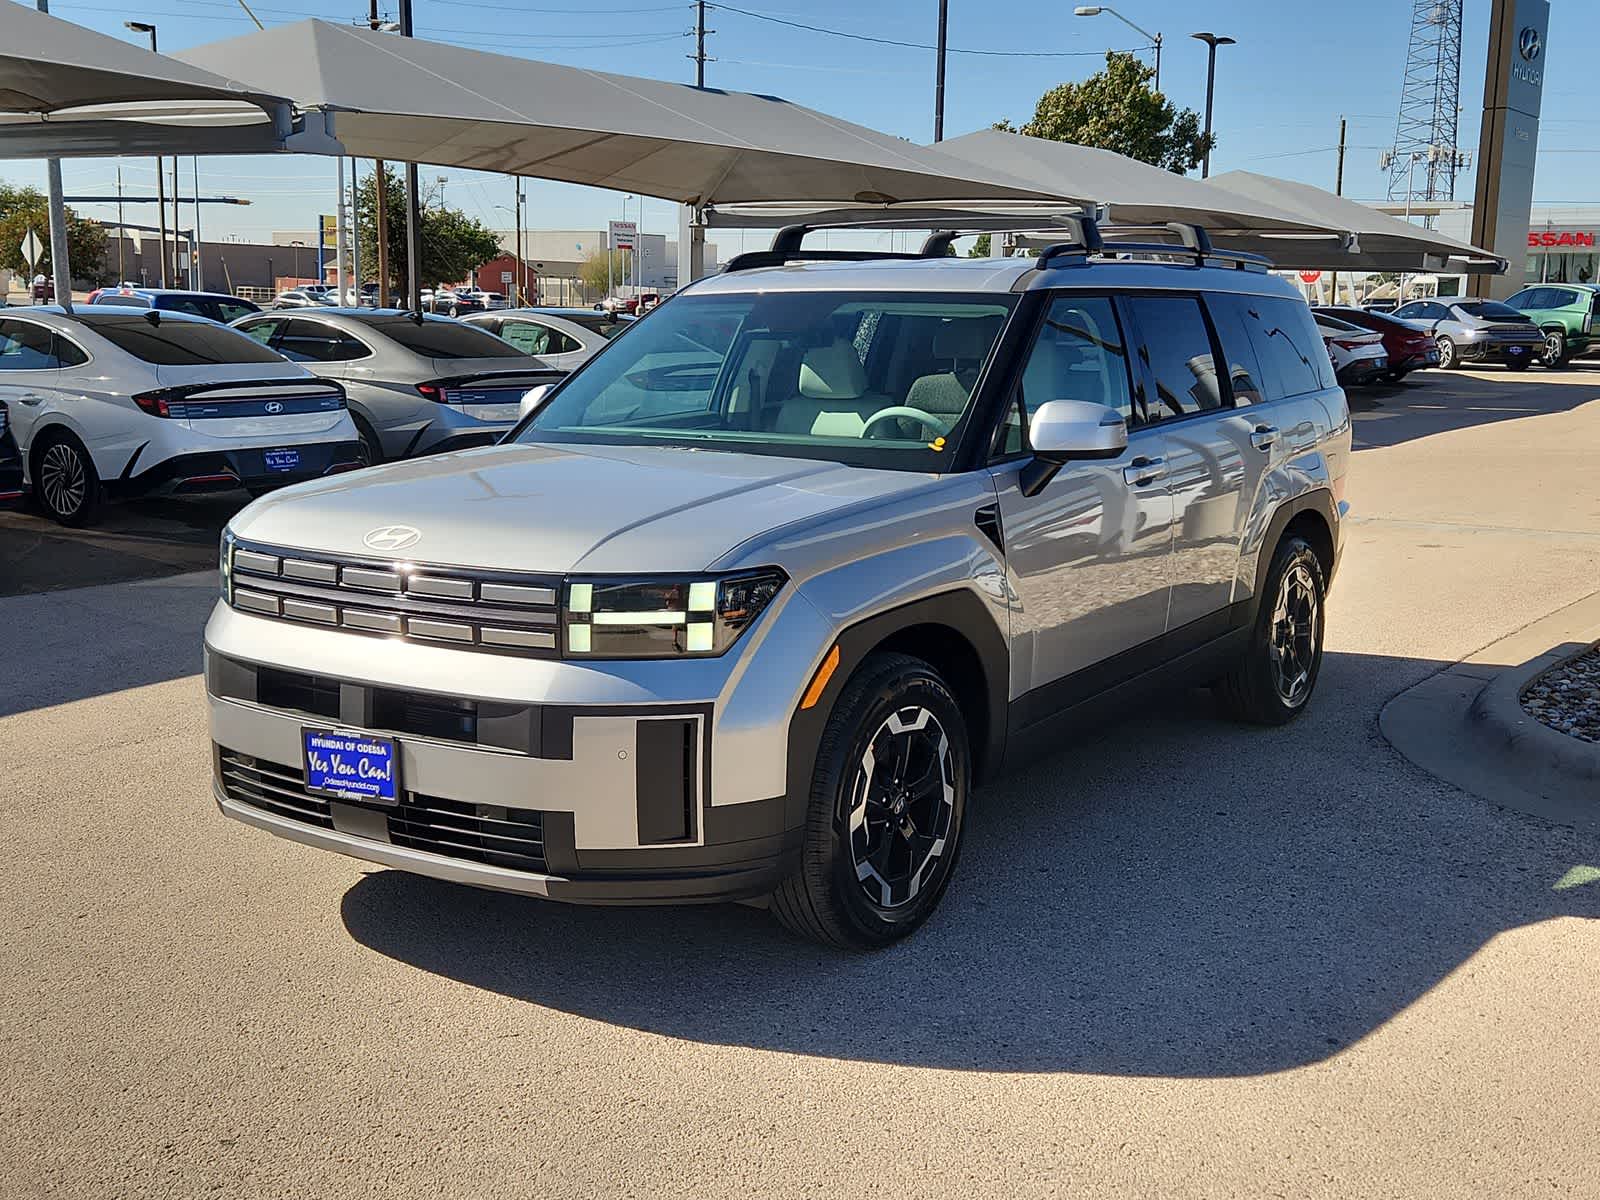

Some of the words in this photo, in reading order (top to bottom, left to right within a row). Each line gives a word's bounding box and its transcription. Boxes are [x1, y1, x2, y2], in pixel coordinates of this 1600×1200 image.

[1513, 63, 1542, 87] HYUNDAI
[311, 738, 344, 750] HYUNDAI
[345, 741, 355, 751] OF
[357, 744, 387, 756] ODESSA
[308, 751, 329, 773] Yes
[330, 754, 357, 775] You
[358, 757, 391, 781] Can!
